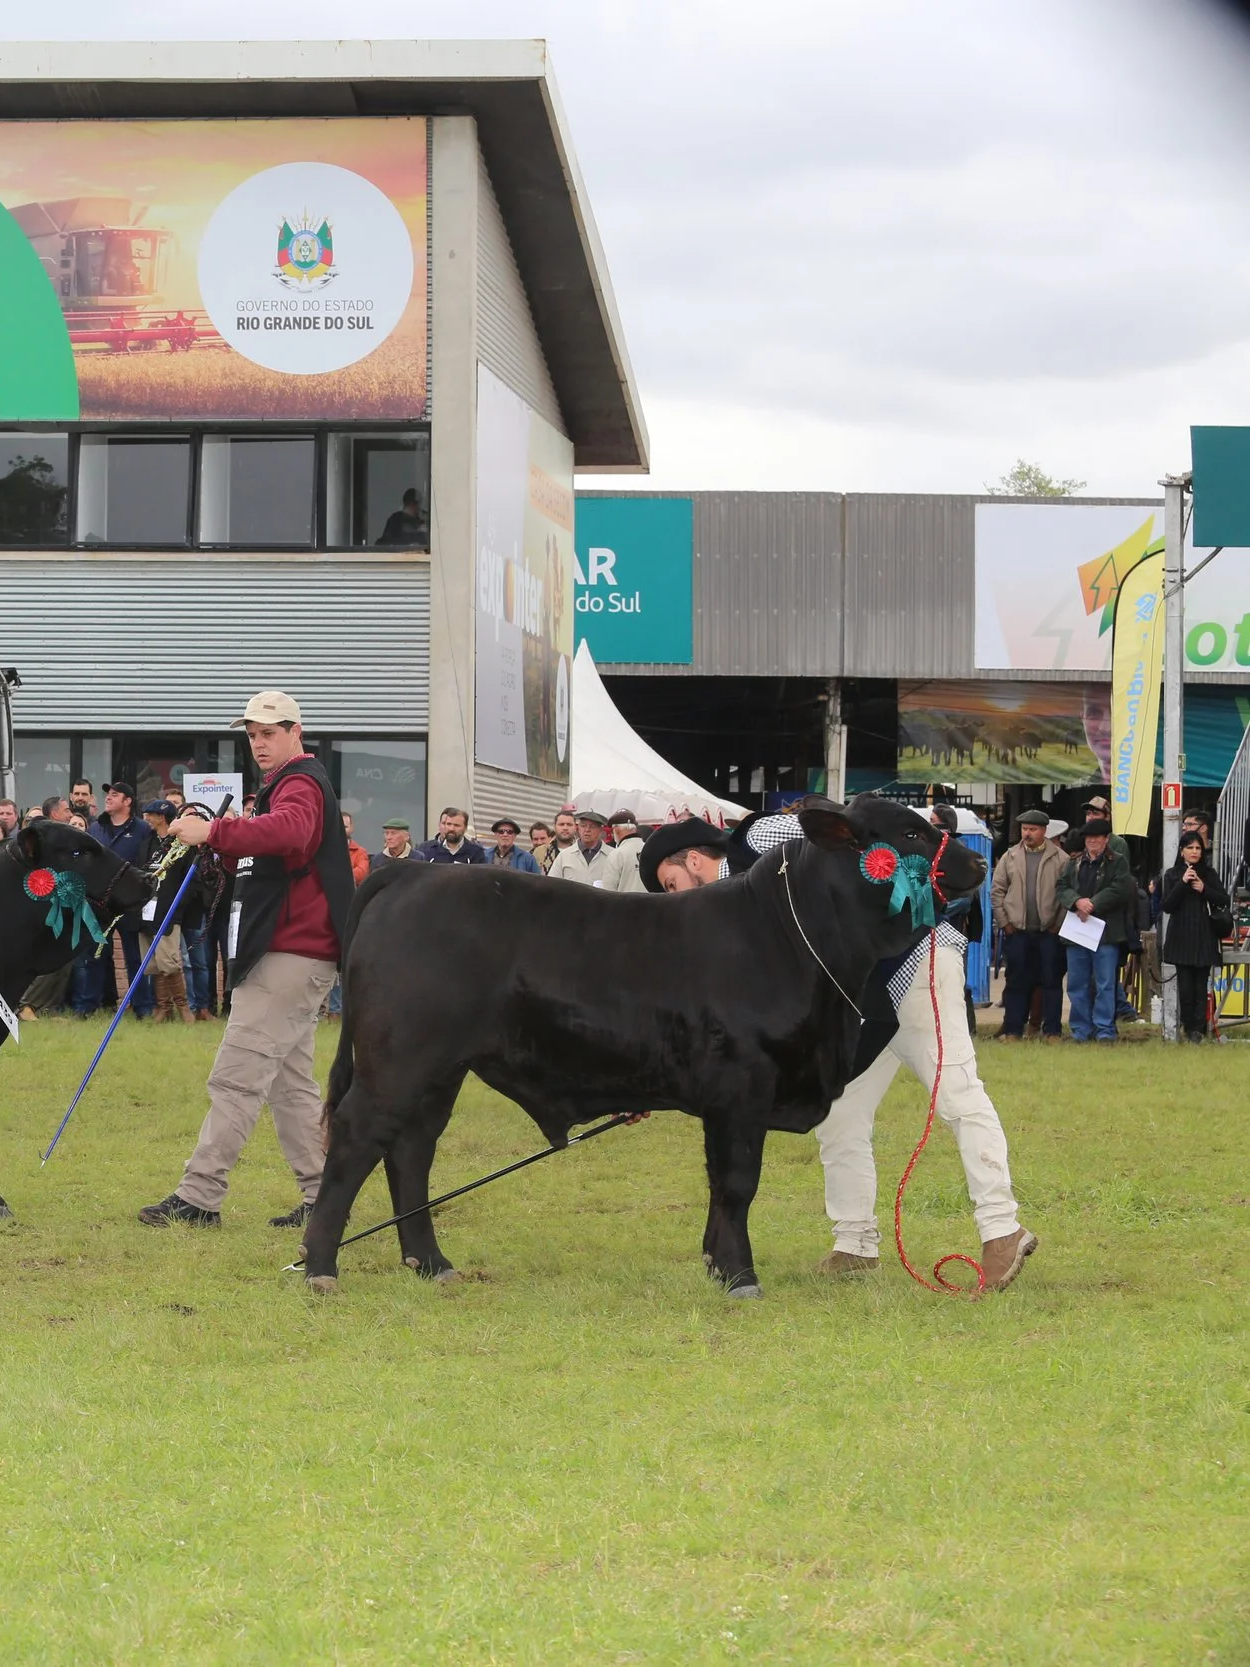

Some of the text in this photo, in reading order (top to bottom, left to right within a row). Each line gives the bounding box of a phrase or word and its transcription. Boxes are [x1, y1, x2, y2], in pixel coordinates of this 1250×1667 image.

[236, 299, 374, 311] GOVERNO DO ESTADO
[236, 315, 374, 330] RIO GRANDE DO SUL
[575, 591, 641, 613] do Sul
[192, 784, 233, 795] Expointer
